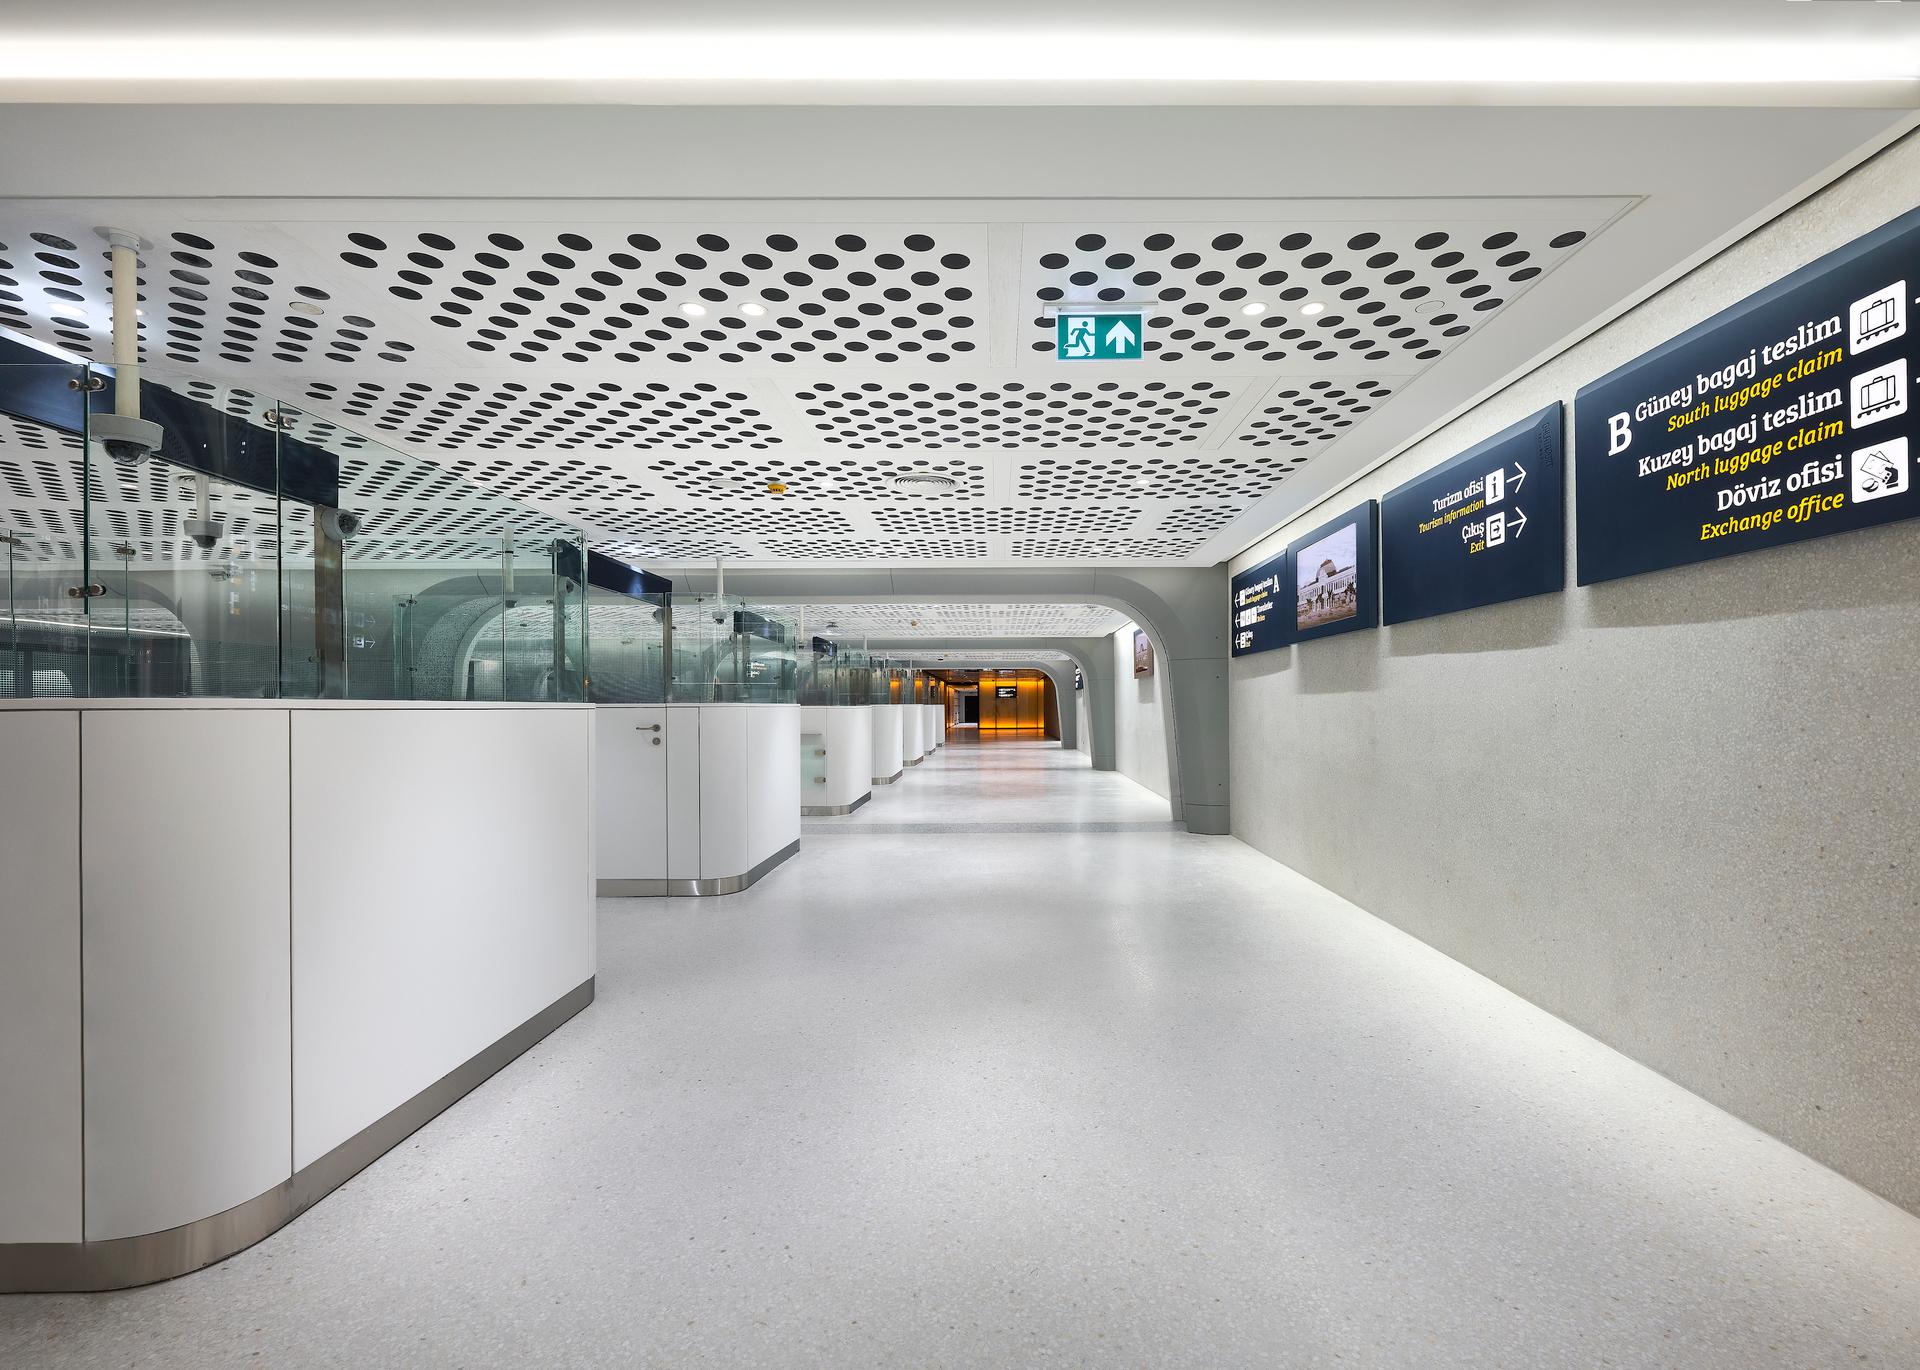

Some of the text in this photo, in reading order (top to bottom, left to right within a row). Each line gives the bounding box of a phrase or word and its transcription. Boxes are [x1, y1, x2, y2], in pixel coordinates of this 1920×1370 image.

[1635, 315, 1842, 422] Güney bagaj teslim
[1667, 347, 1843, 432] South luggage claim
[1607, 411, 1633, 457] B
[1638, 387, 1843, 478] Kuzey bagaj teslim
[1666, 419, 1844, 491] North luggage claim
[1432, 476, 1484, 513] Turizm ofisi
[1717, 454, 1845, 512] Döviz ofisi
[1419, 499, 1485, 534] Tourism information
[1462, 521, 1485, 544] Çıkış
[1700, 493, 1845, 541] Exchange office
[1470, 539, 1485, 554] Exit
[1273, 574, 1280, 594] A
